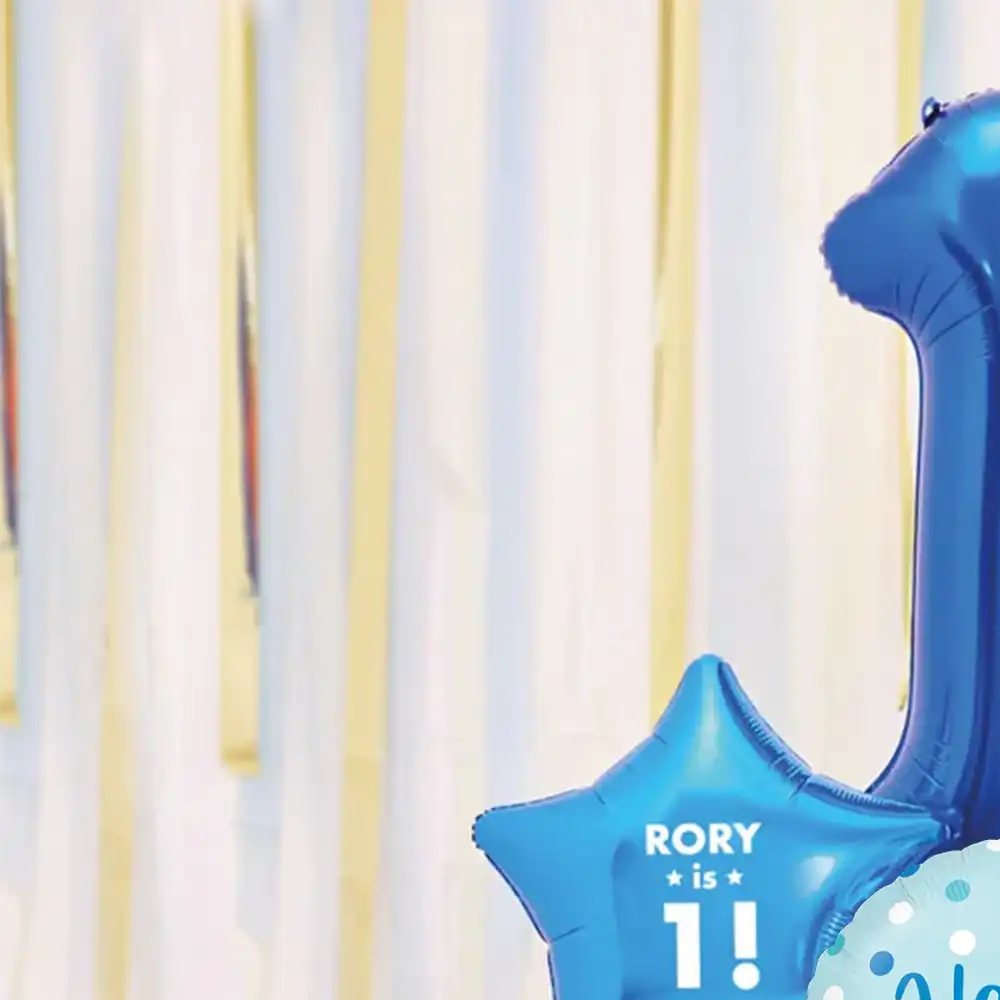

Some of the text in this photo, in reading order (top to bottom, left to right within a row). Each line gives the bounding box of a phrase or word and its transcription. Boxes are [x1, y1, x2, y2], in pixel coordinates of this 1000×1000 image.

[645, 822, 762, 856] RORY
[692, 862, 718, 889] is
[663, 901, 760, 990] 1!
